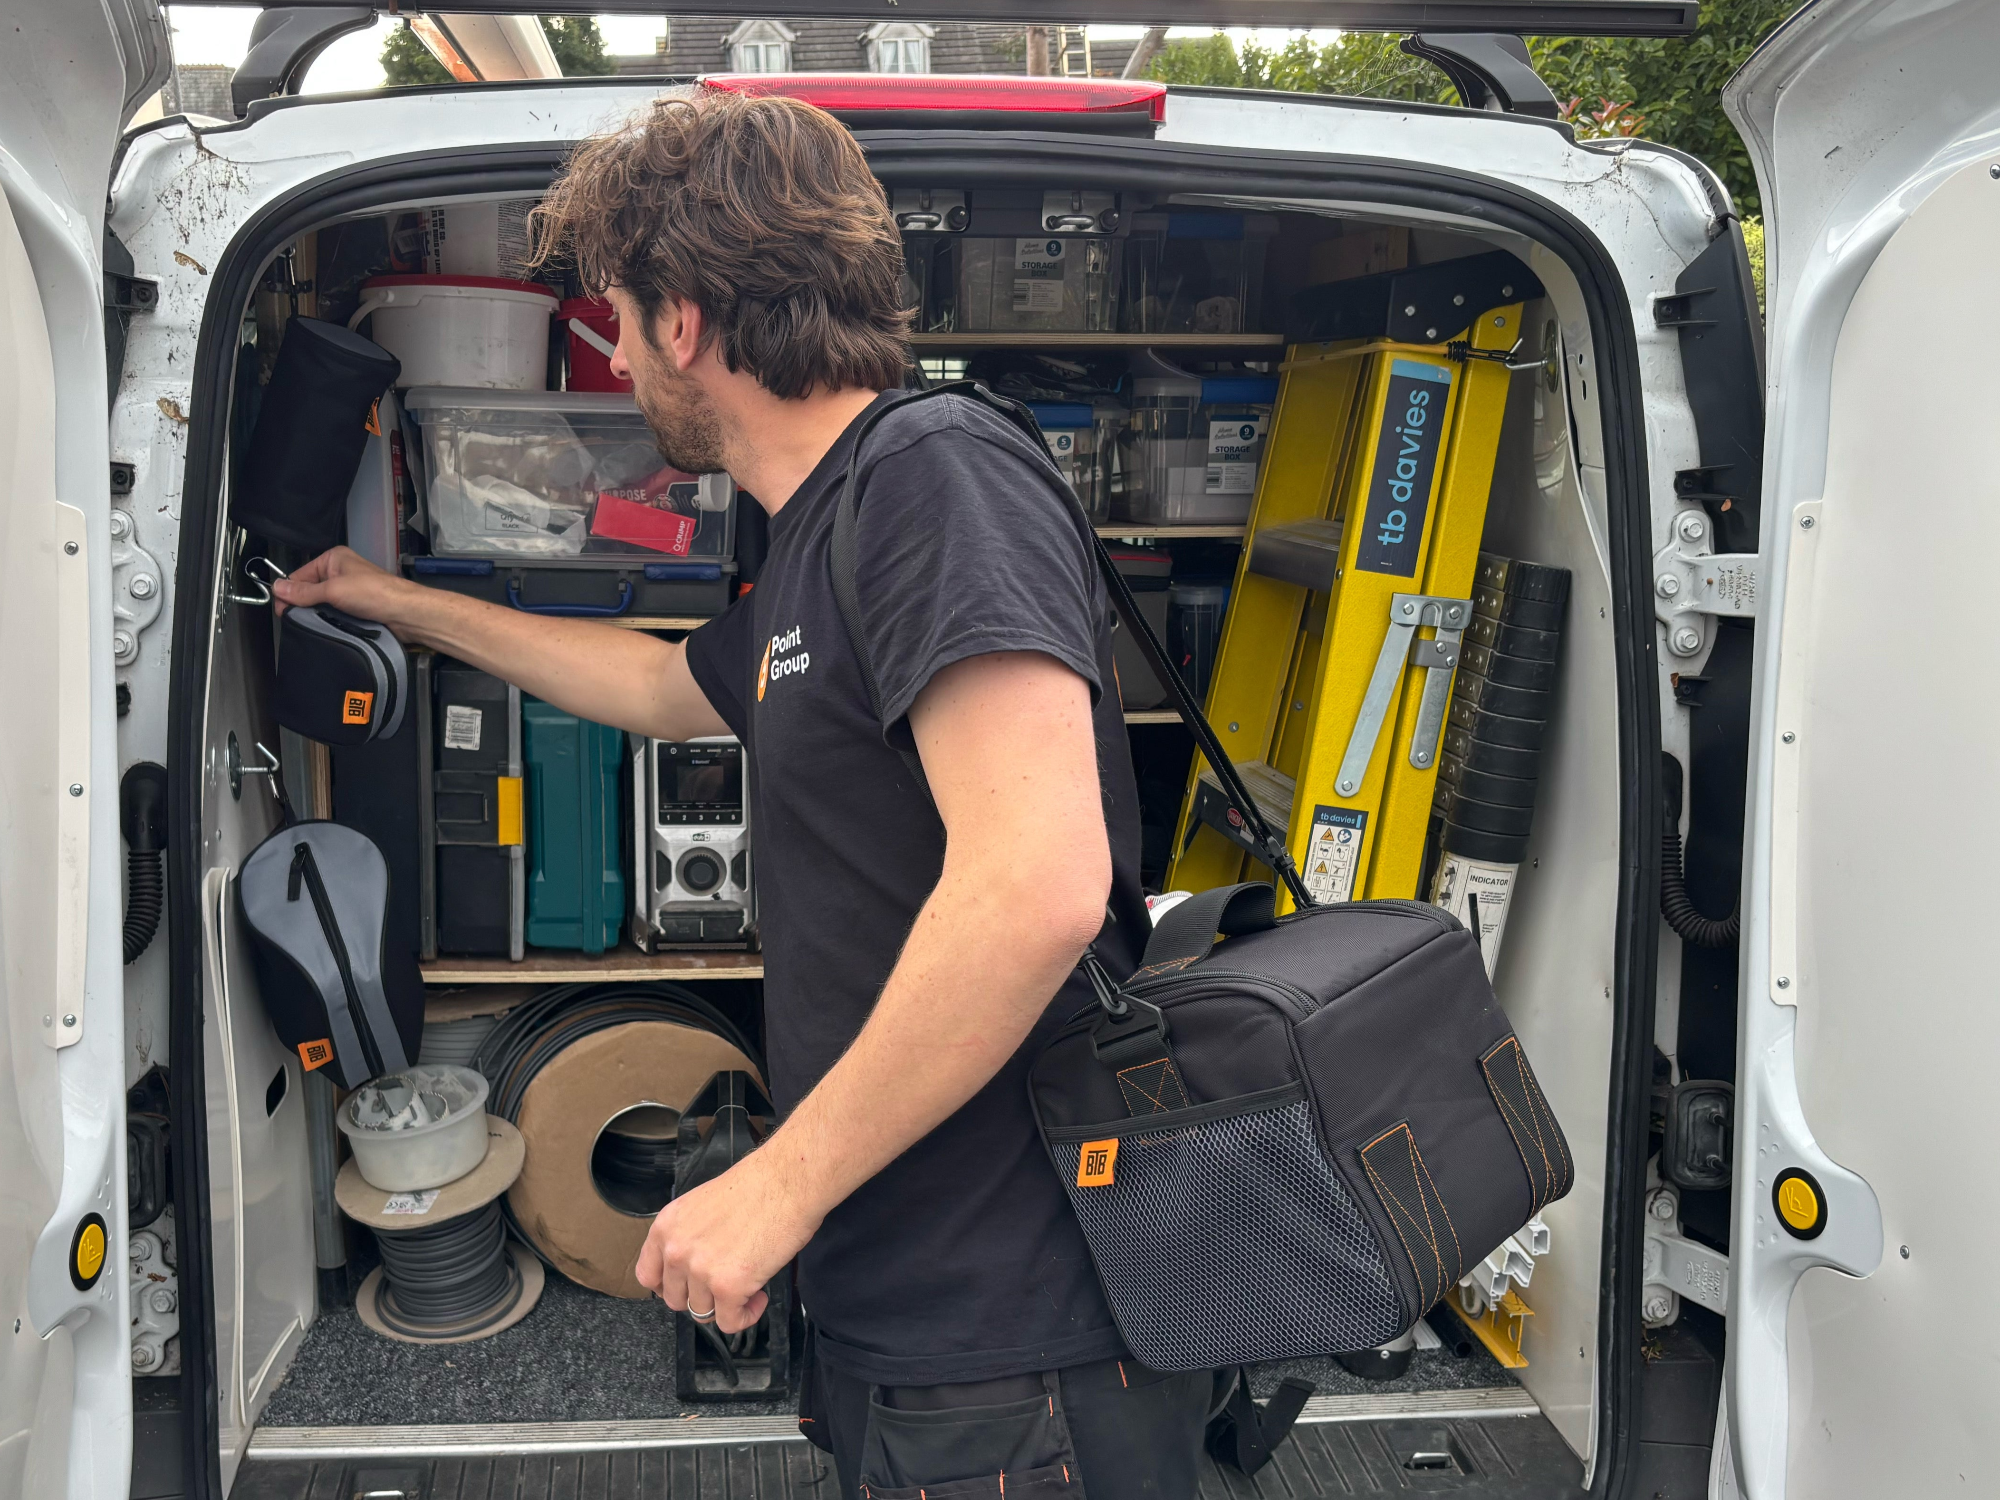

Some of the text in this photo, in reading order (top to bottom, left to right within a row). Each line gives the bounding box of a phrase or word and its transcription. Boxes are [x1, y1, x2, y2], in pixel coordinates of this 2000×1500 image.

[1021, 261, 1058, 269] STORAGE
[1031, 269, 1047, 277] BOX
[1244, 427, 1250, 435] 9
[1224, 453, 1241, 461] BOX
[1378, 389, 1430, 545] tb davies
[771, 625, 801, 656] Point
[770, 652, 810, 681] Group
[349, 698, 366, 717] BTB
[1321, 812, 1329, 821] tb
[1330, 814, 1355, 824] davies
[1469, 874, 1509, 886] INDICATOR
[307, 1044, 327, 1062] BTB
[1086, 1149, 1109, 1176] BTB
